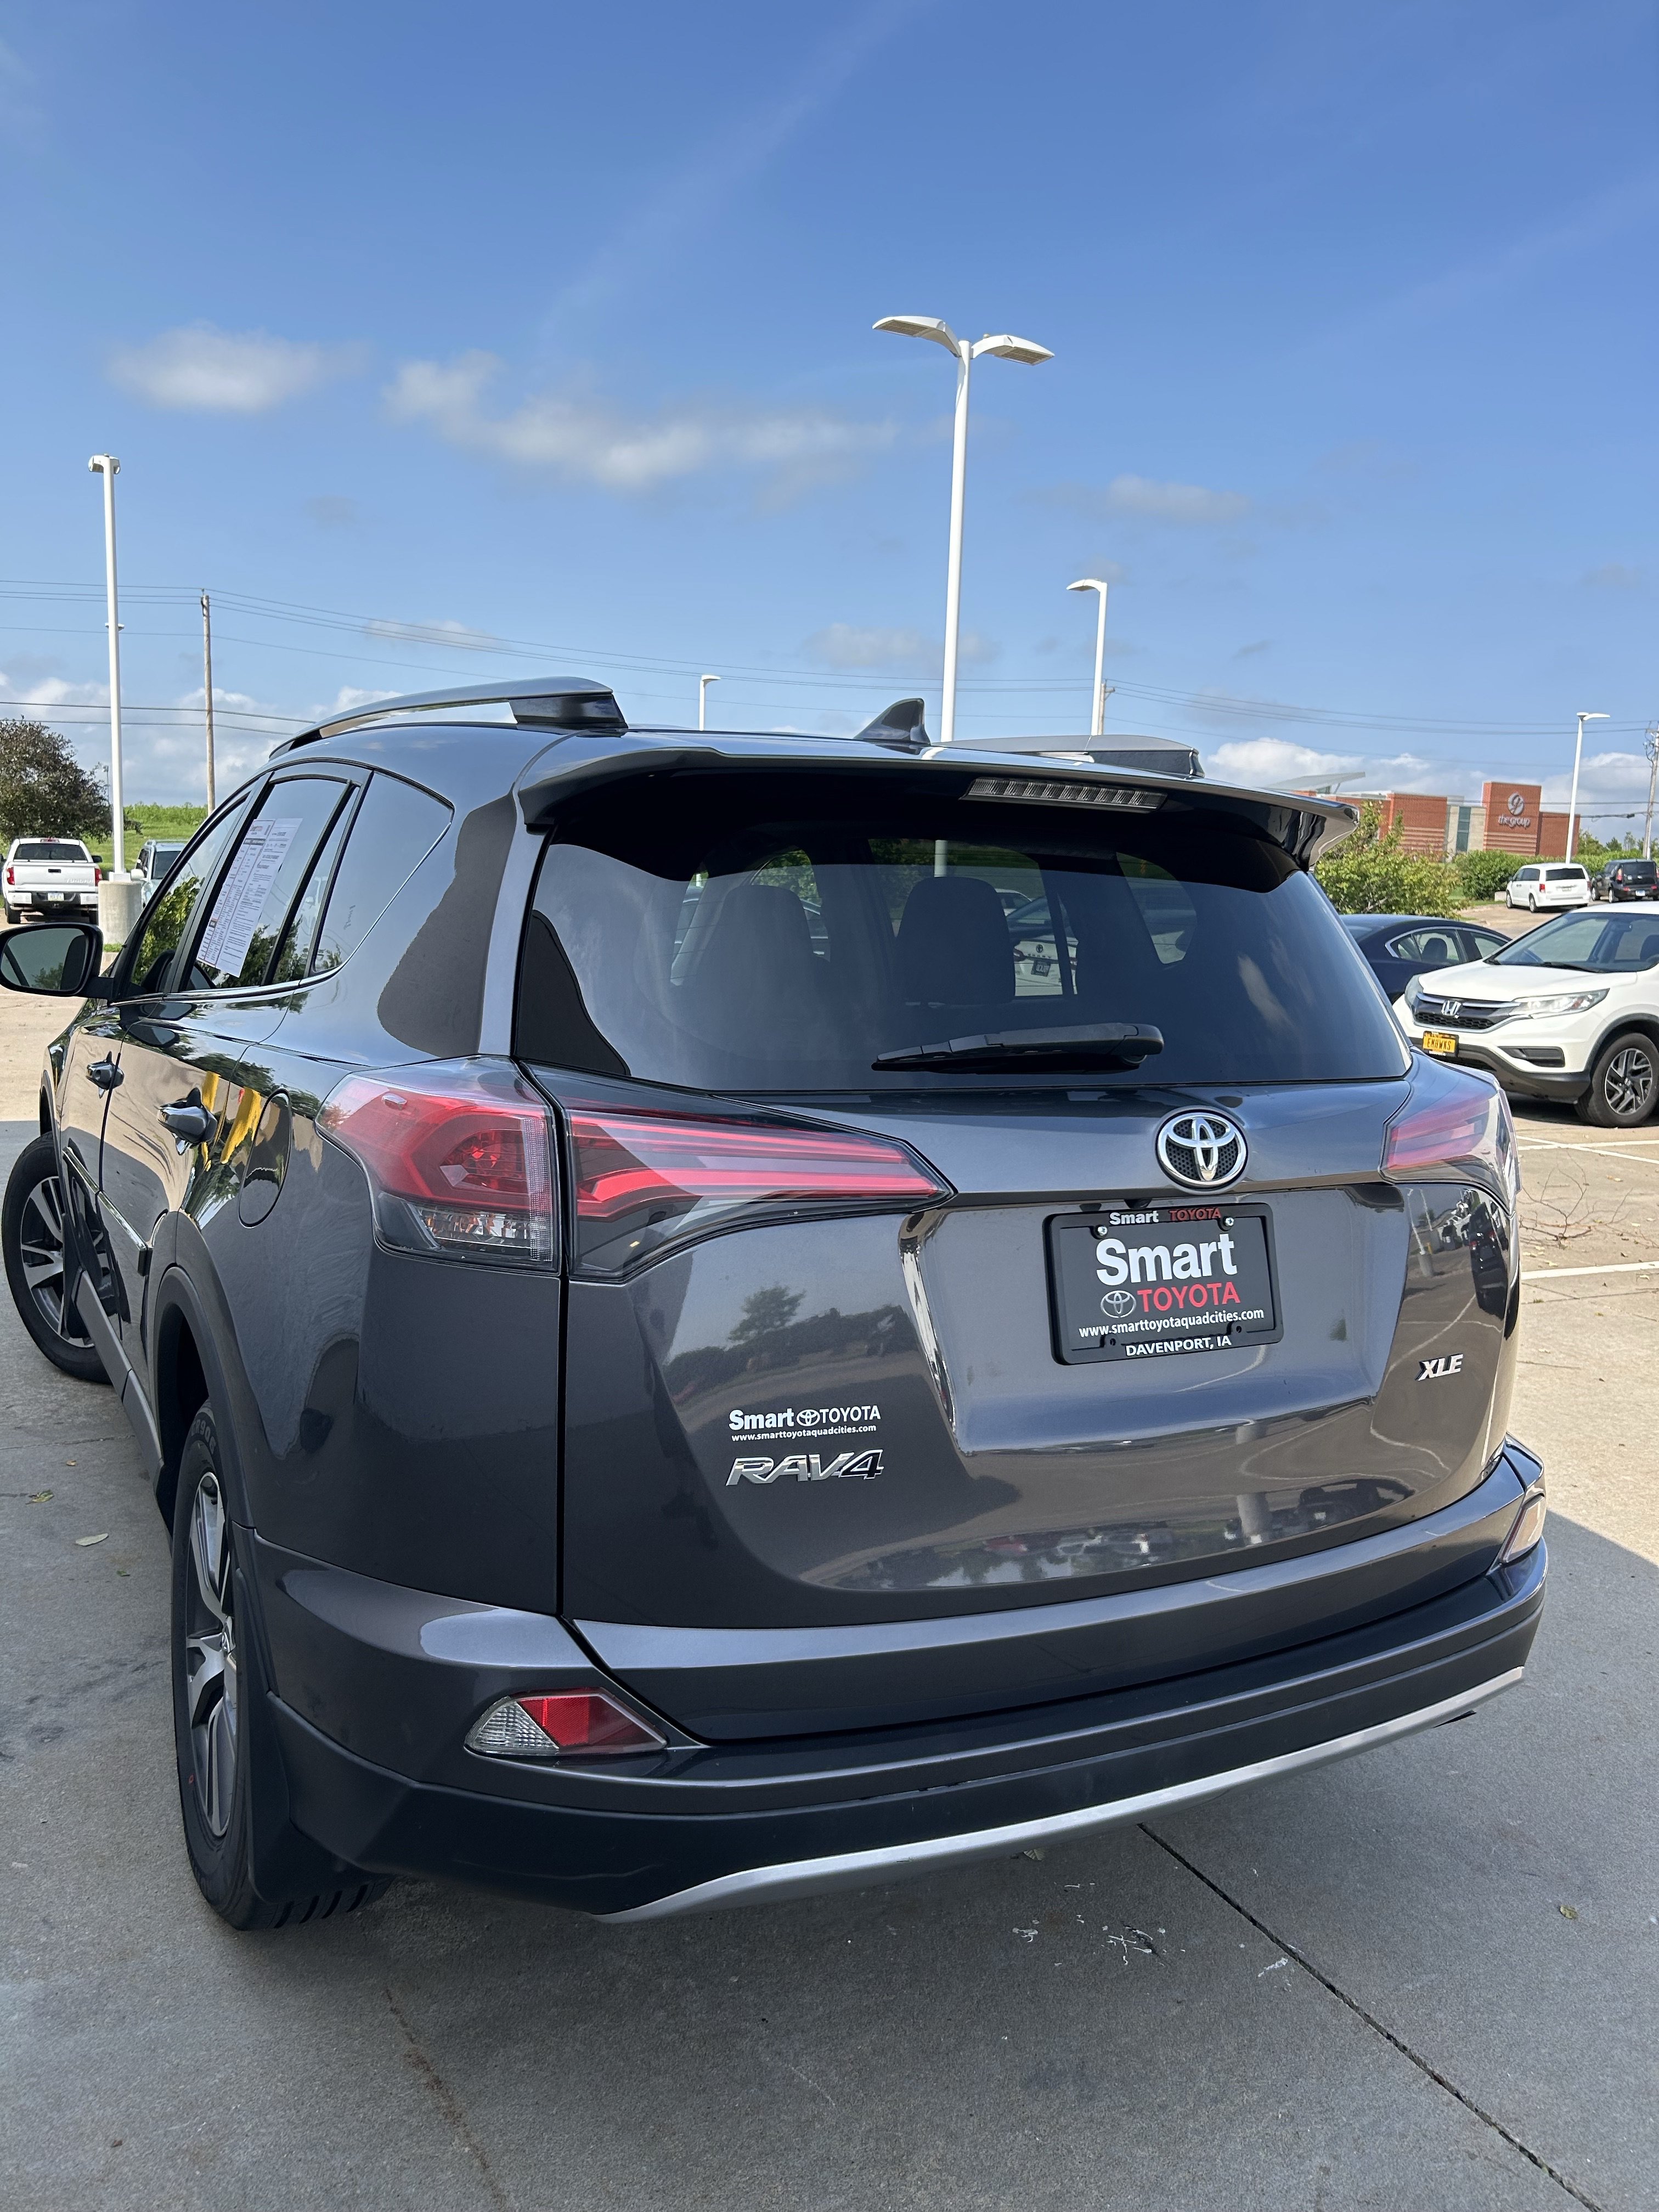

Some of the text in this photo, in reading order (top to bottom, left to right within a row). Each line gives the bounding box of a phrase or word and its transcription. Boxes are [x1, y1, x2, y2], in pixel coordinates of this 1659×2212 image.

[1109, 1207, 1221, 1225] Smart TOYOTA
[1096, 1233, 1238, 1286] Smart
[1137, 1282, 1241, 1312] TOYOTA
[1079, 1308, 1265, 1338] www.smarttoyotaquadcities.com
[1125, 1335, 1232, 1356] DAVENPORT, IA
[1415, 1353, 1464, 1381] XLE
[729, 1405, 881, 1430] Smart TOYOTA
[731, 1424, 877, 1442] www.smarttoyotaquadcities.com
[725, 1449, 884, 1486] RAV4
